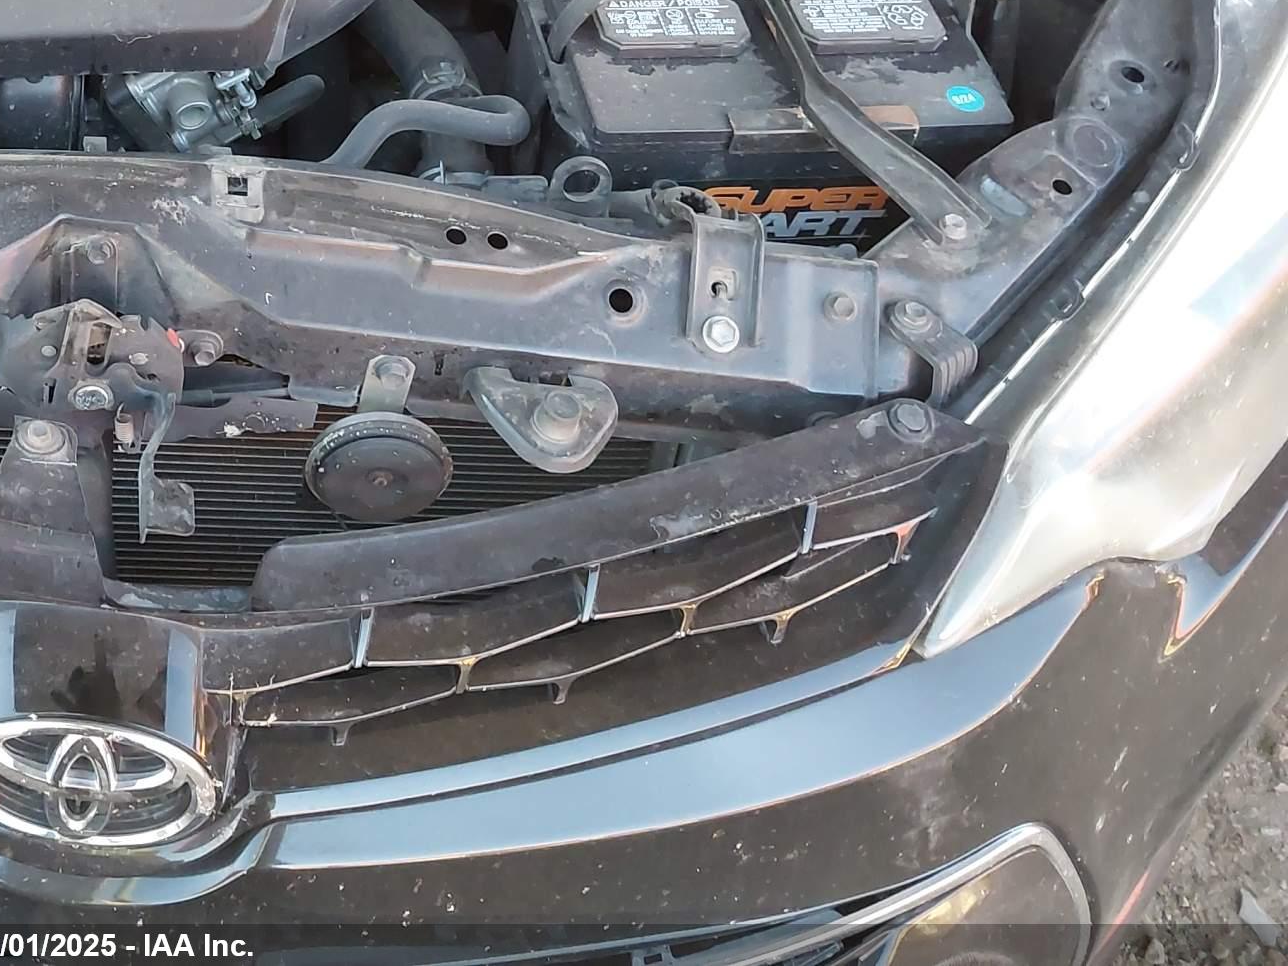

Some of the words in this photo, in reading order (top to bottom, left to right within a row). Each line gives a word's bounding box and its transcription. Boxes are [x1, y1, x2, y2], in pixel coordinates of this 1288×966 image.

[618, 0, 666, 8] DANGER
[704, 186, 889, 214] SUPER
[760, 209, 886, 238] ART
